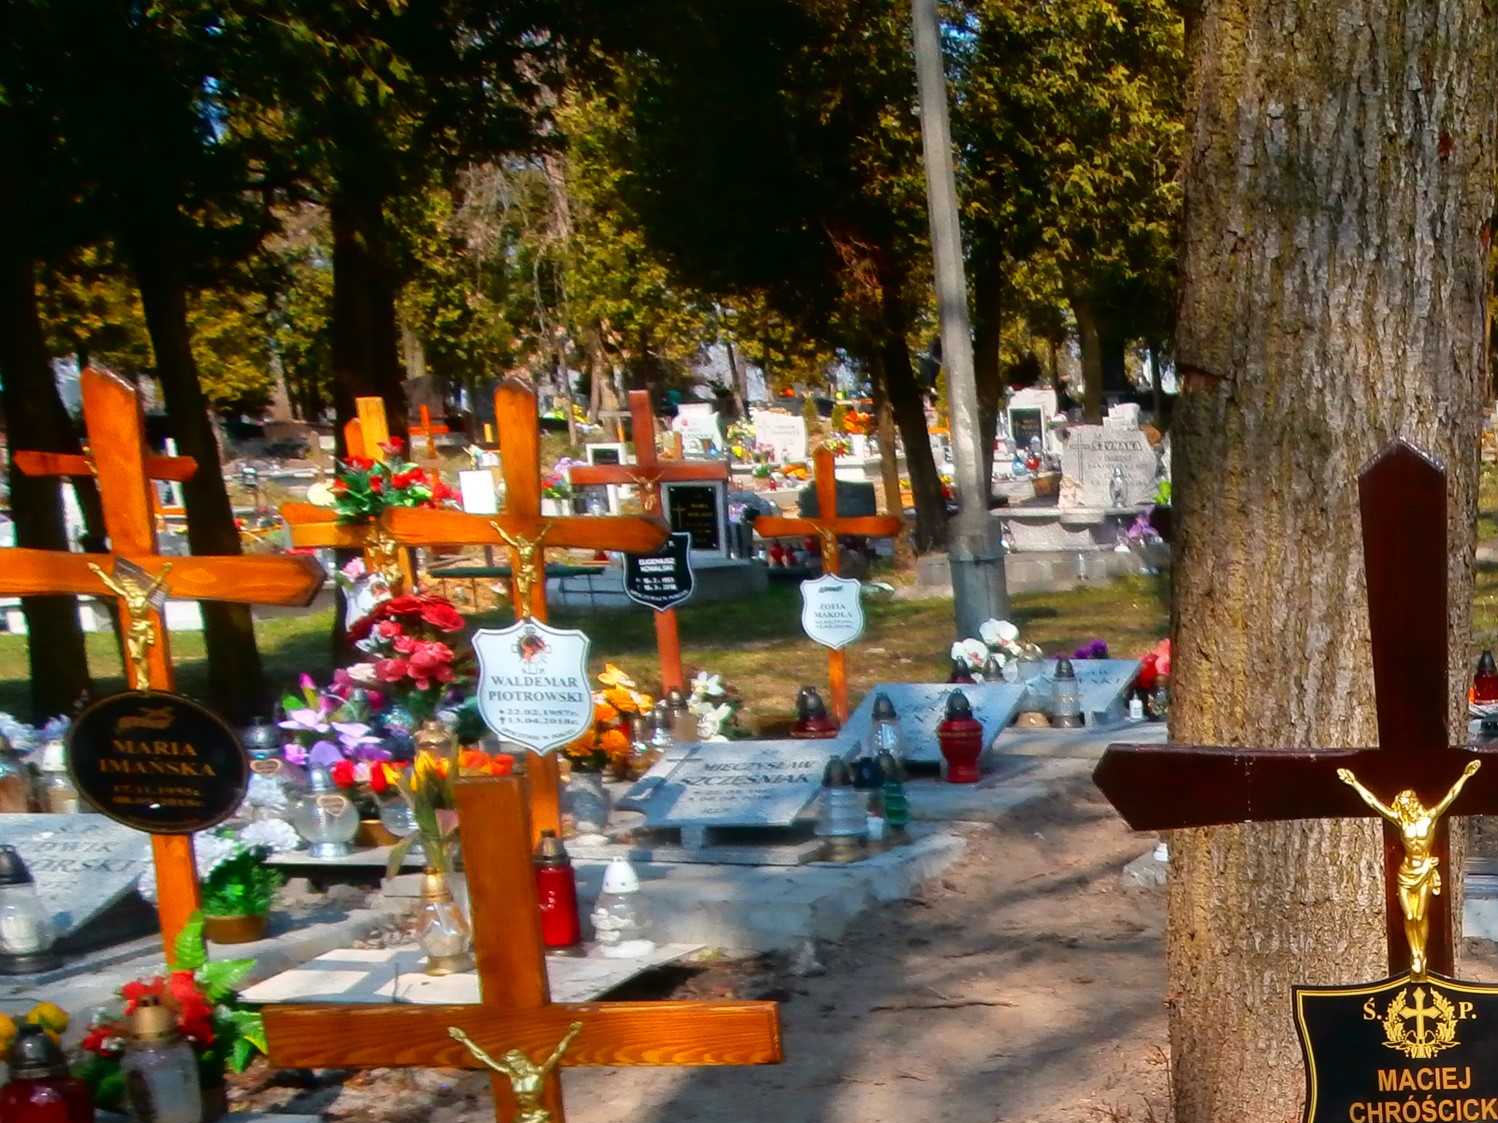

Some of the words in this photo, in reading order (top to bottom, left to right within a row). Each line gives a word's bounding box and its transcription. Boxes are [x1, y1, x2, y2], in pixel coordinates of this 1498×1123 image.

[490, 675, 579, 688] WALDEMAR
[488, 690, 583, 703] PIOTROWSKI
[112, 739, 198, 757] MARIA
[1363, 997, 1382, 1020] Ś.
[1459, 1001, 1477, 1020] P.
[1377, 1066, 1472, 1092] MACIEJ
